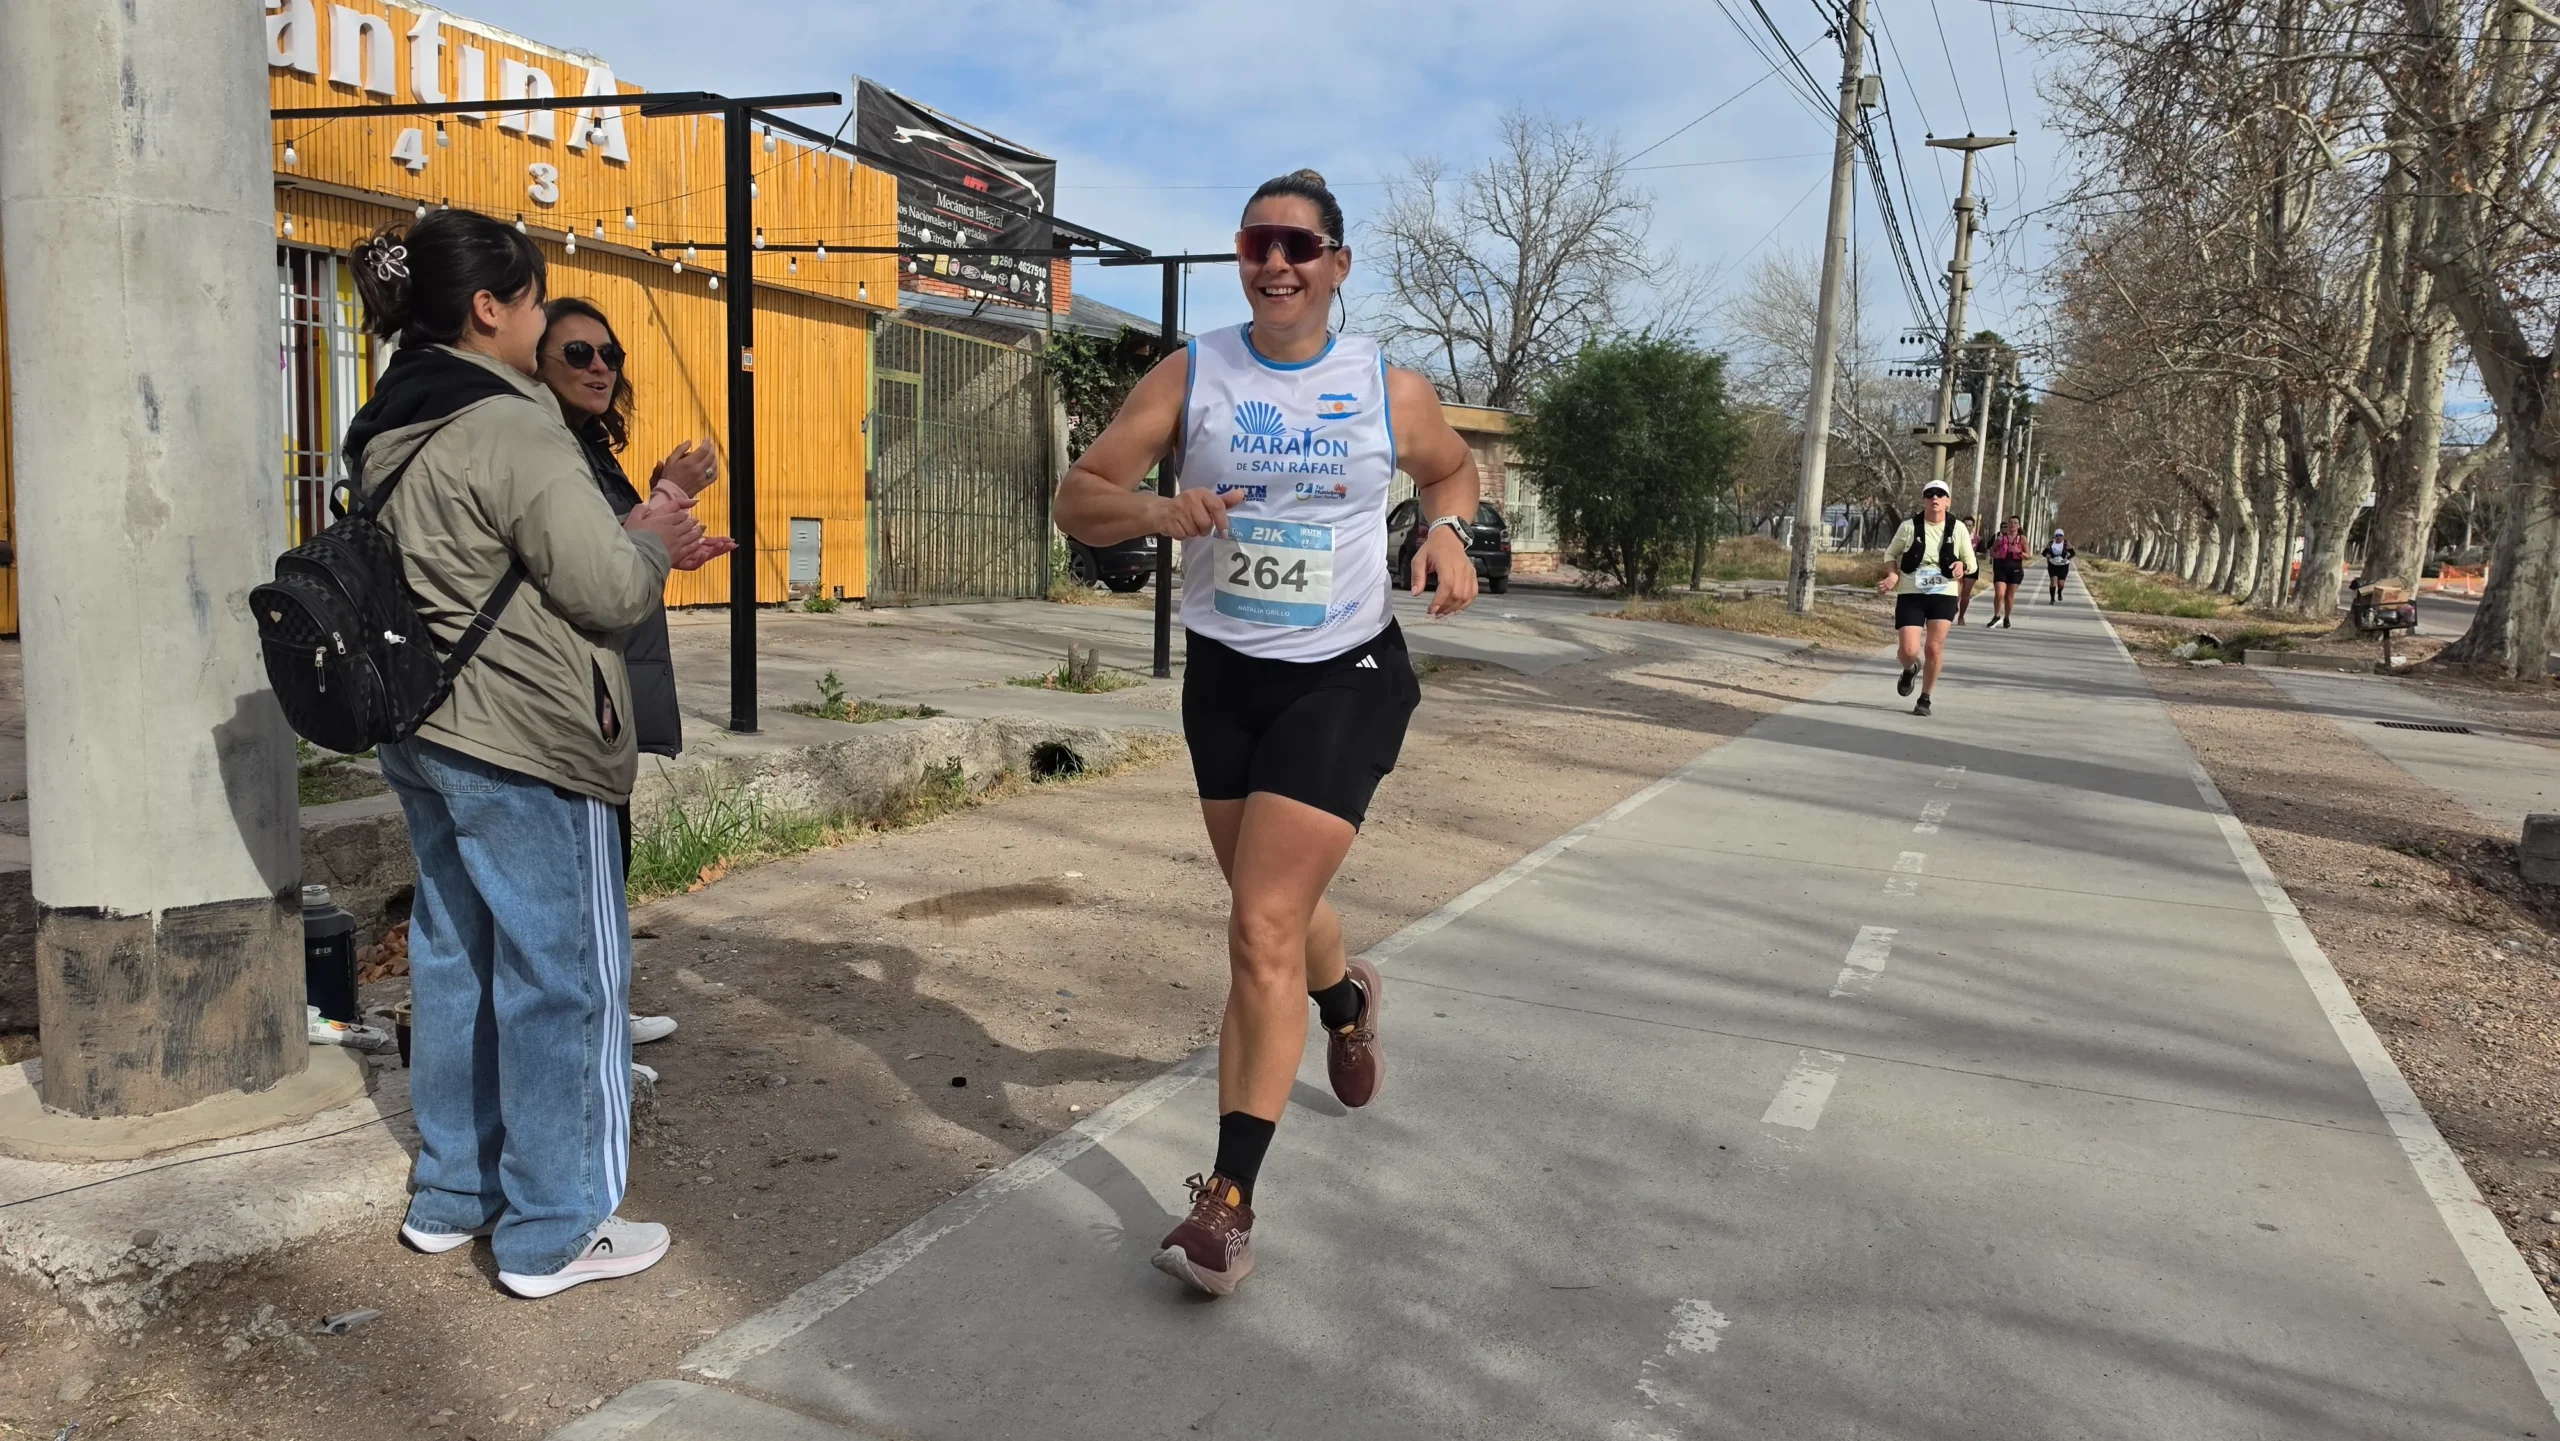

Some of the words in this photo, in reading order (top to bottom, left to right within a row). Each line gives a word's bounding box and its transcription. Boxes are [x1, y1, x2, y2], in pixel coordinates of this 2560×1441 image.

[391, 128, 429, 171] 4
[528, 163, 559, 203] 3
[909, 205, 947, 228] Nacionales
[947, 223, 953, 231] e
[937, 192, 974, 218] Mecánica
[976, 206, 1004, 229] Integral
[999, 255, 1013, 268] 260
[1018, 260, 1047, 278] 4627510
[981, 270, 997, 285] Jeep
[1236, 462, 1247, 471] DE
[1251, 460, 1284, 473] SAN
[1288, 462, 1346, 475] RAFAEL
[1251, 527, 1287, 542] 21K
[1228, 552, 1308, 592] 264
[1921, 576, 1942, 586] 343
[1237, 604, 1264, 614] NATALIA
[1265, 609, 1291, 617] GRILLO
